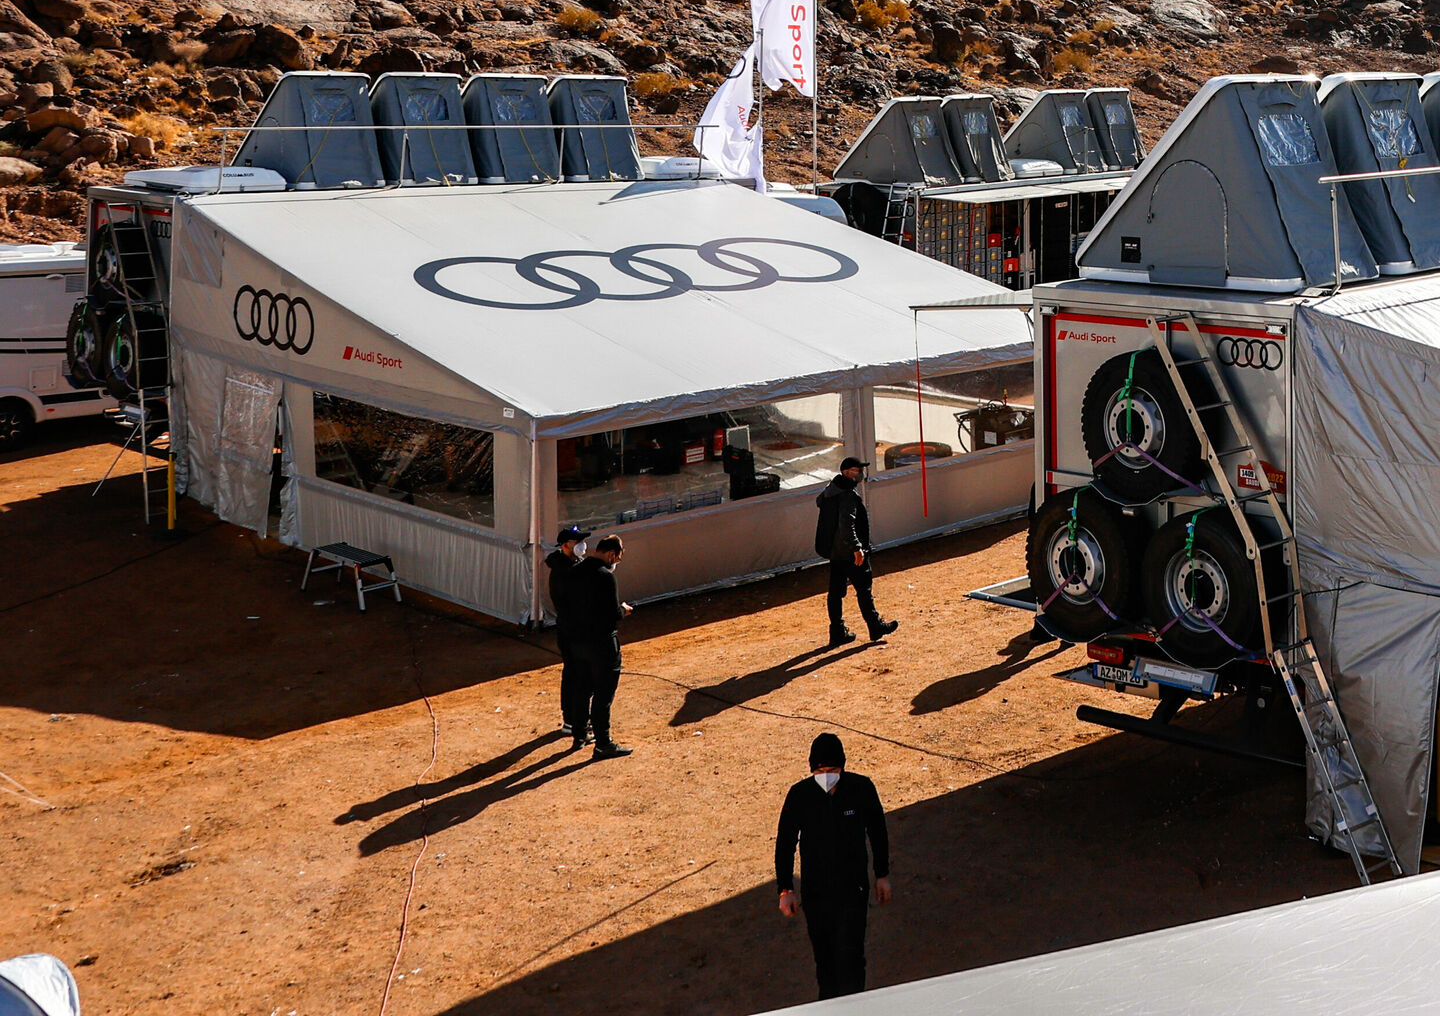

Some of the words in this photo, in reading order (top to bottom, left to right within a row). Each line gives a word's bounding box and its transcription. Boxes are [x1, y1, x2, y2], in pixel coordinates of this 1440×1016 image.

[788, 5, 807, 88] Sport
[1069, 331, 1089, 341] Audi
[1090, 333, 1116, 344] Sport
[354, 348, 375, 362] Audi
[376, 353, 402, 369] Sport
[1100, 666, 1111, 678] AZ
[1116, 669, 1128, 681] QM
